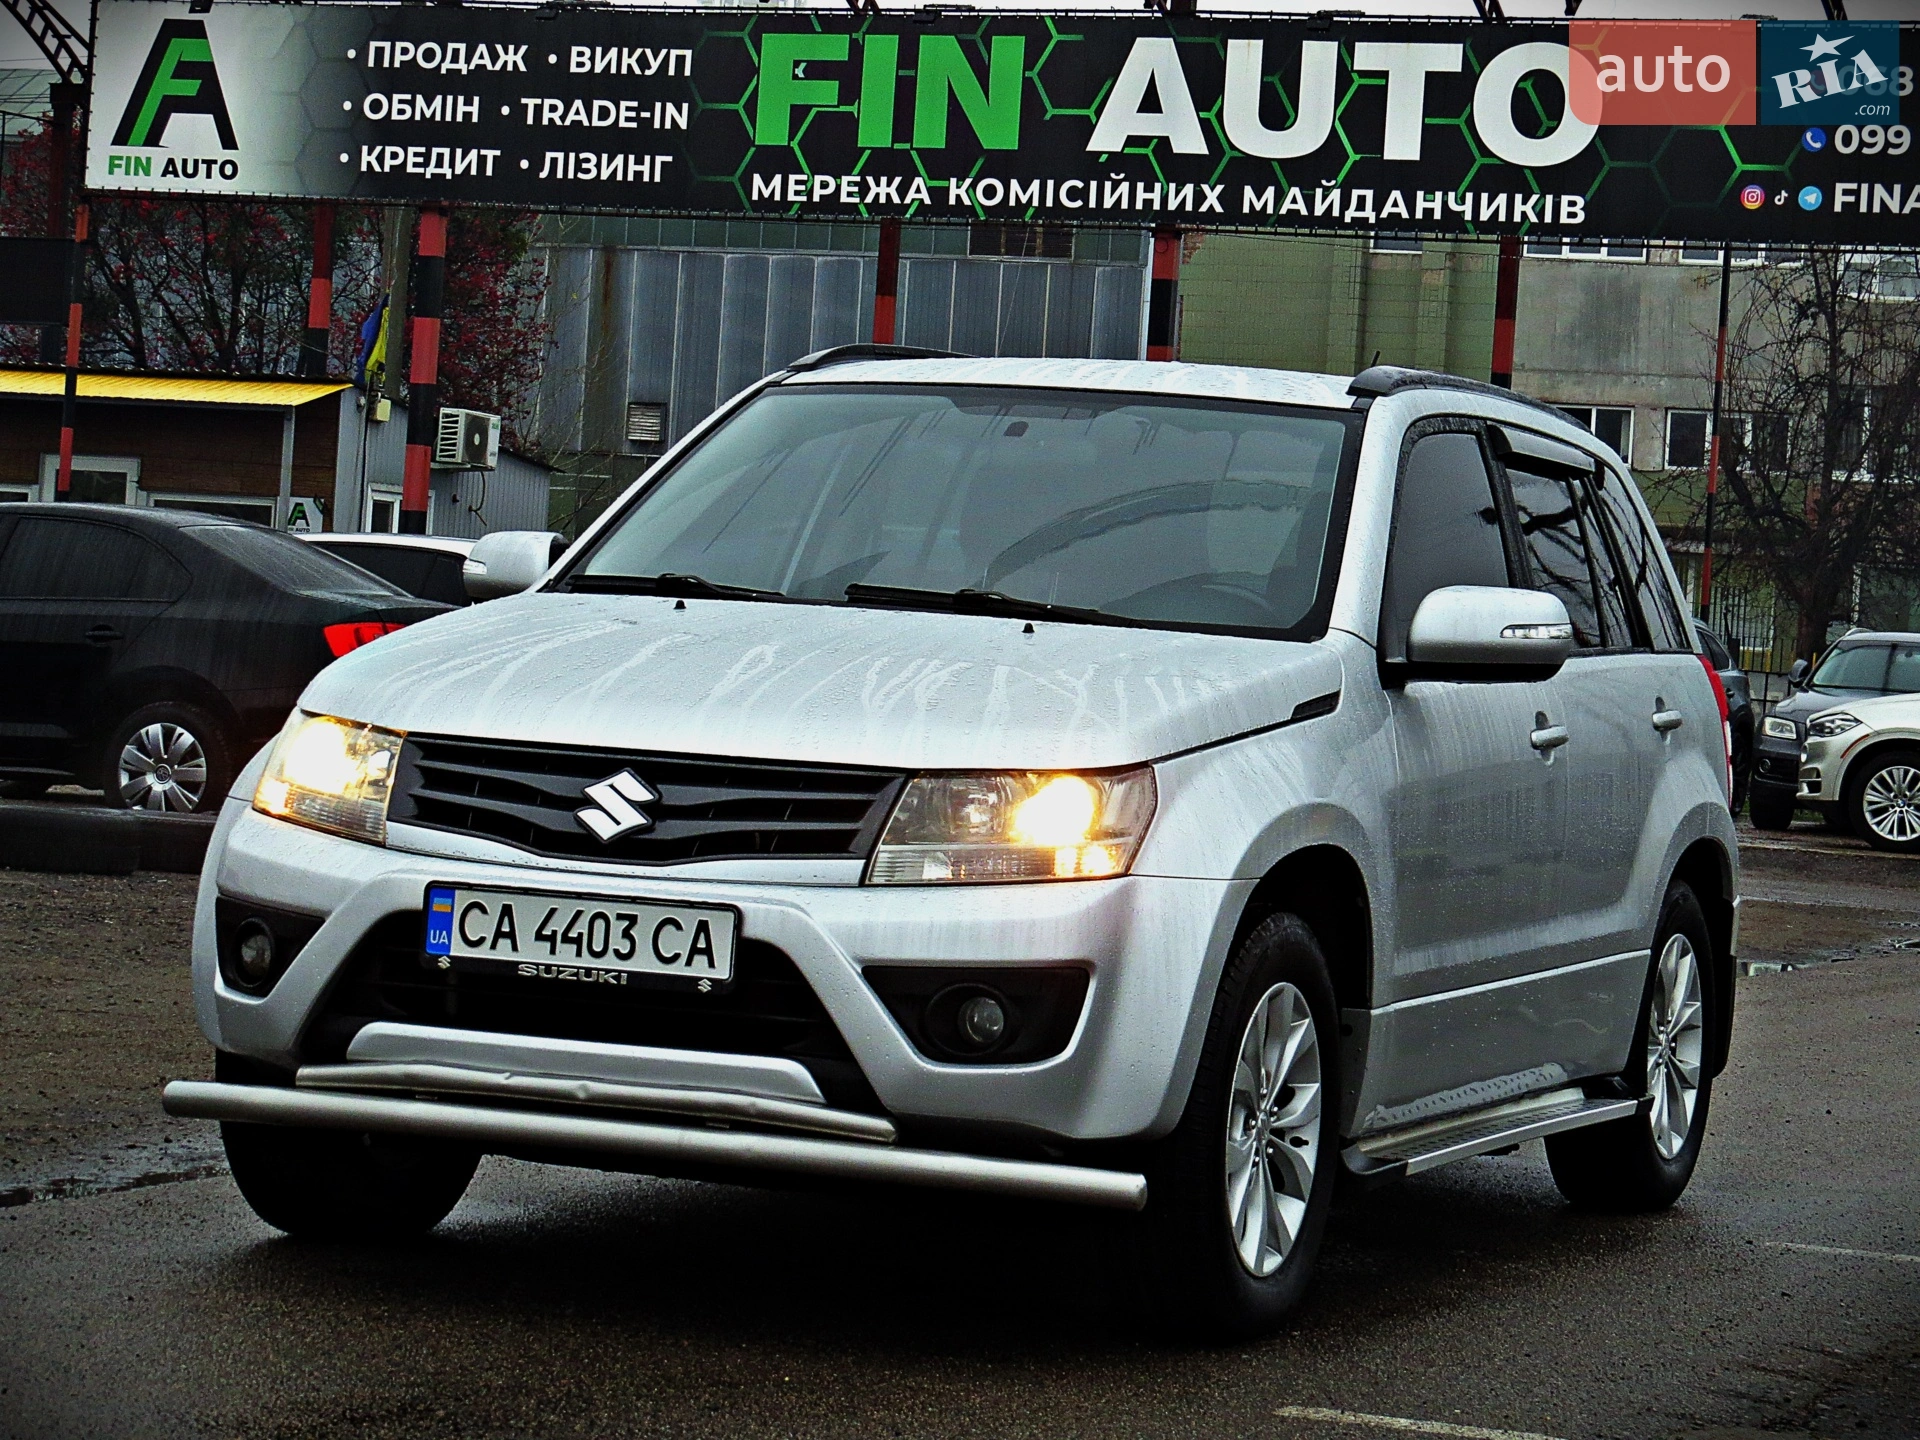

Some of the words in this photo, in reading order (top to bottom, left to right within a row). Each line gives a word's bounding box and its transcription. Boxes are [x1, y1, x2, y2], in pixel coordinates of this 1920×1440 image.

[368, 41, 528, 74] ПРОДАЖ
[570, 46, 693, 77] ВИКУП
[363, 93, 480, 122] ОБМІН
[521, 98, 689, 130] TRADE-IN
[755, 32, 1025, 151] FIN
[1086, 37, 1603, 167] AUTO
[1834, 124, 1911, 155] 099
[108, 155, 152, 177] FIN
[160, 157, 239, 181] AUTO
[360, 145, 501, 179] КРЕДИТ
[539, 152, 673, 183] ЛІЗИНГ
[752, 174, 931, 204] МЕРЕЖА
[948, 173, 1225, 213] КОМІСІЙНИХ
[1239, 179, 1587, 225] МАЙДАНЧИКІВ
[430, 929, 449, 945] UA
[458, 900, 519, 953] CA
[534, 906, 639, 961] 4403
[651, 916, 716, 969] CA
[518, 963, 628, 985] SUZUKI
